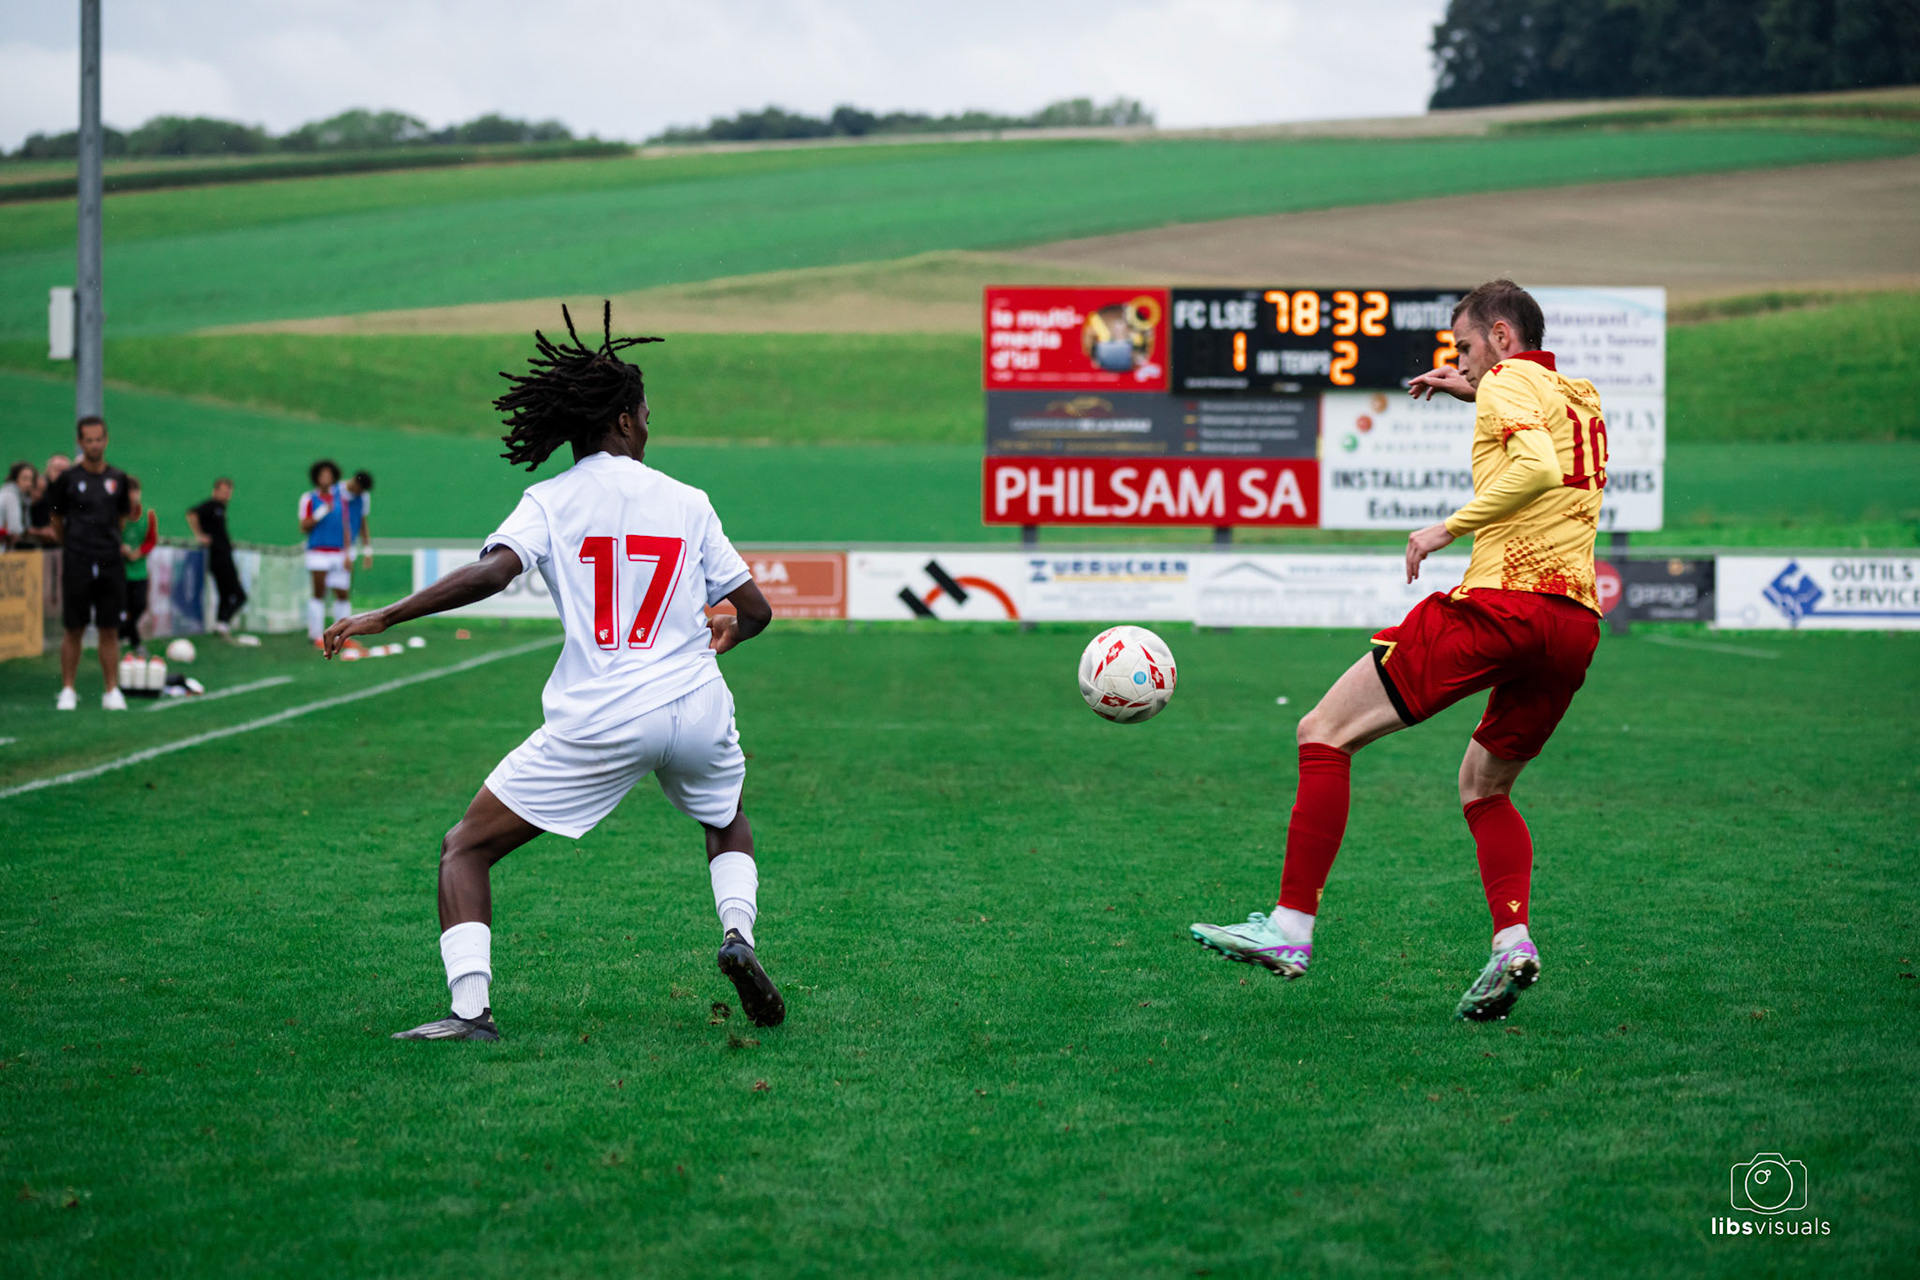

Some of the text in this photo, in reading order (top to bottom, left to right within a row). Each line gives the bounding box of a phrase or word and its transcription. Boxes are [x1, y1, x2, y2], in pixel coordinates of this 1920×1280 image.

[1173, 300, 1257, 329] FC LSE
[1264, 290, 1389, 337] 78:32
[1232, 331, 1247, 372] 1
[1329, 340, 1359, 386] 2
[995, 466, 1307, 519] PHILSAM SA
[1332, 469, 1475, 490] INSTALLATIO
[578, 534, 687, 650] 17
[752, 560, 790, 583] SA
[1831, 563, 1915, 582] OUTILS
